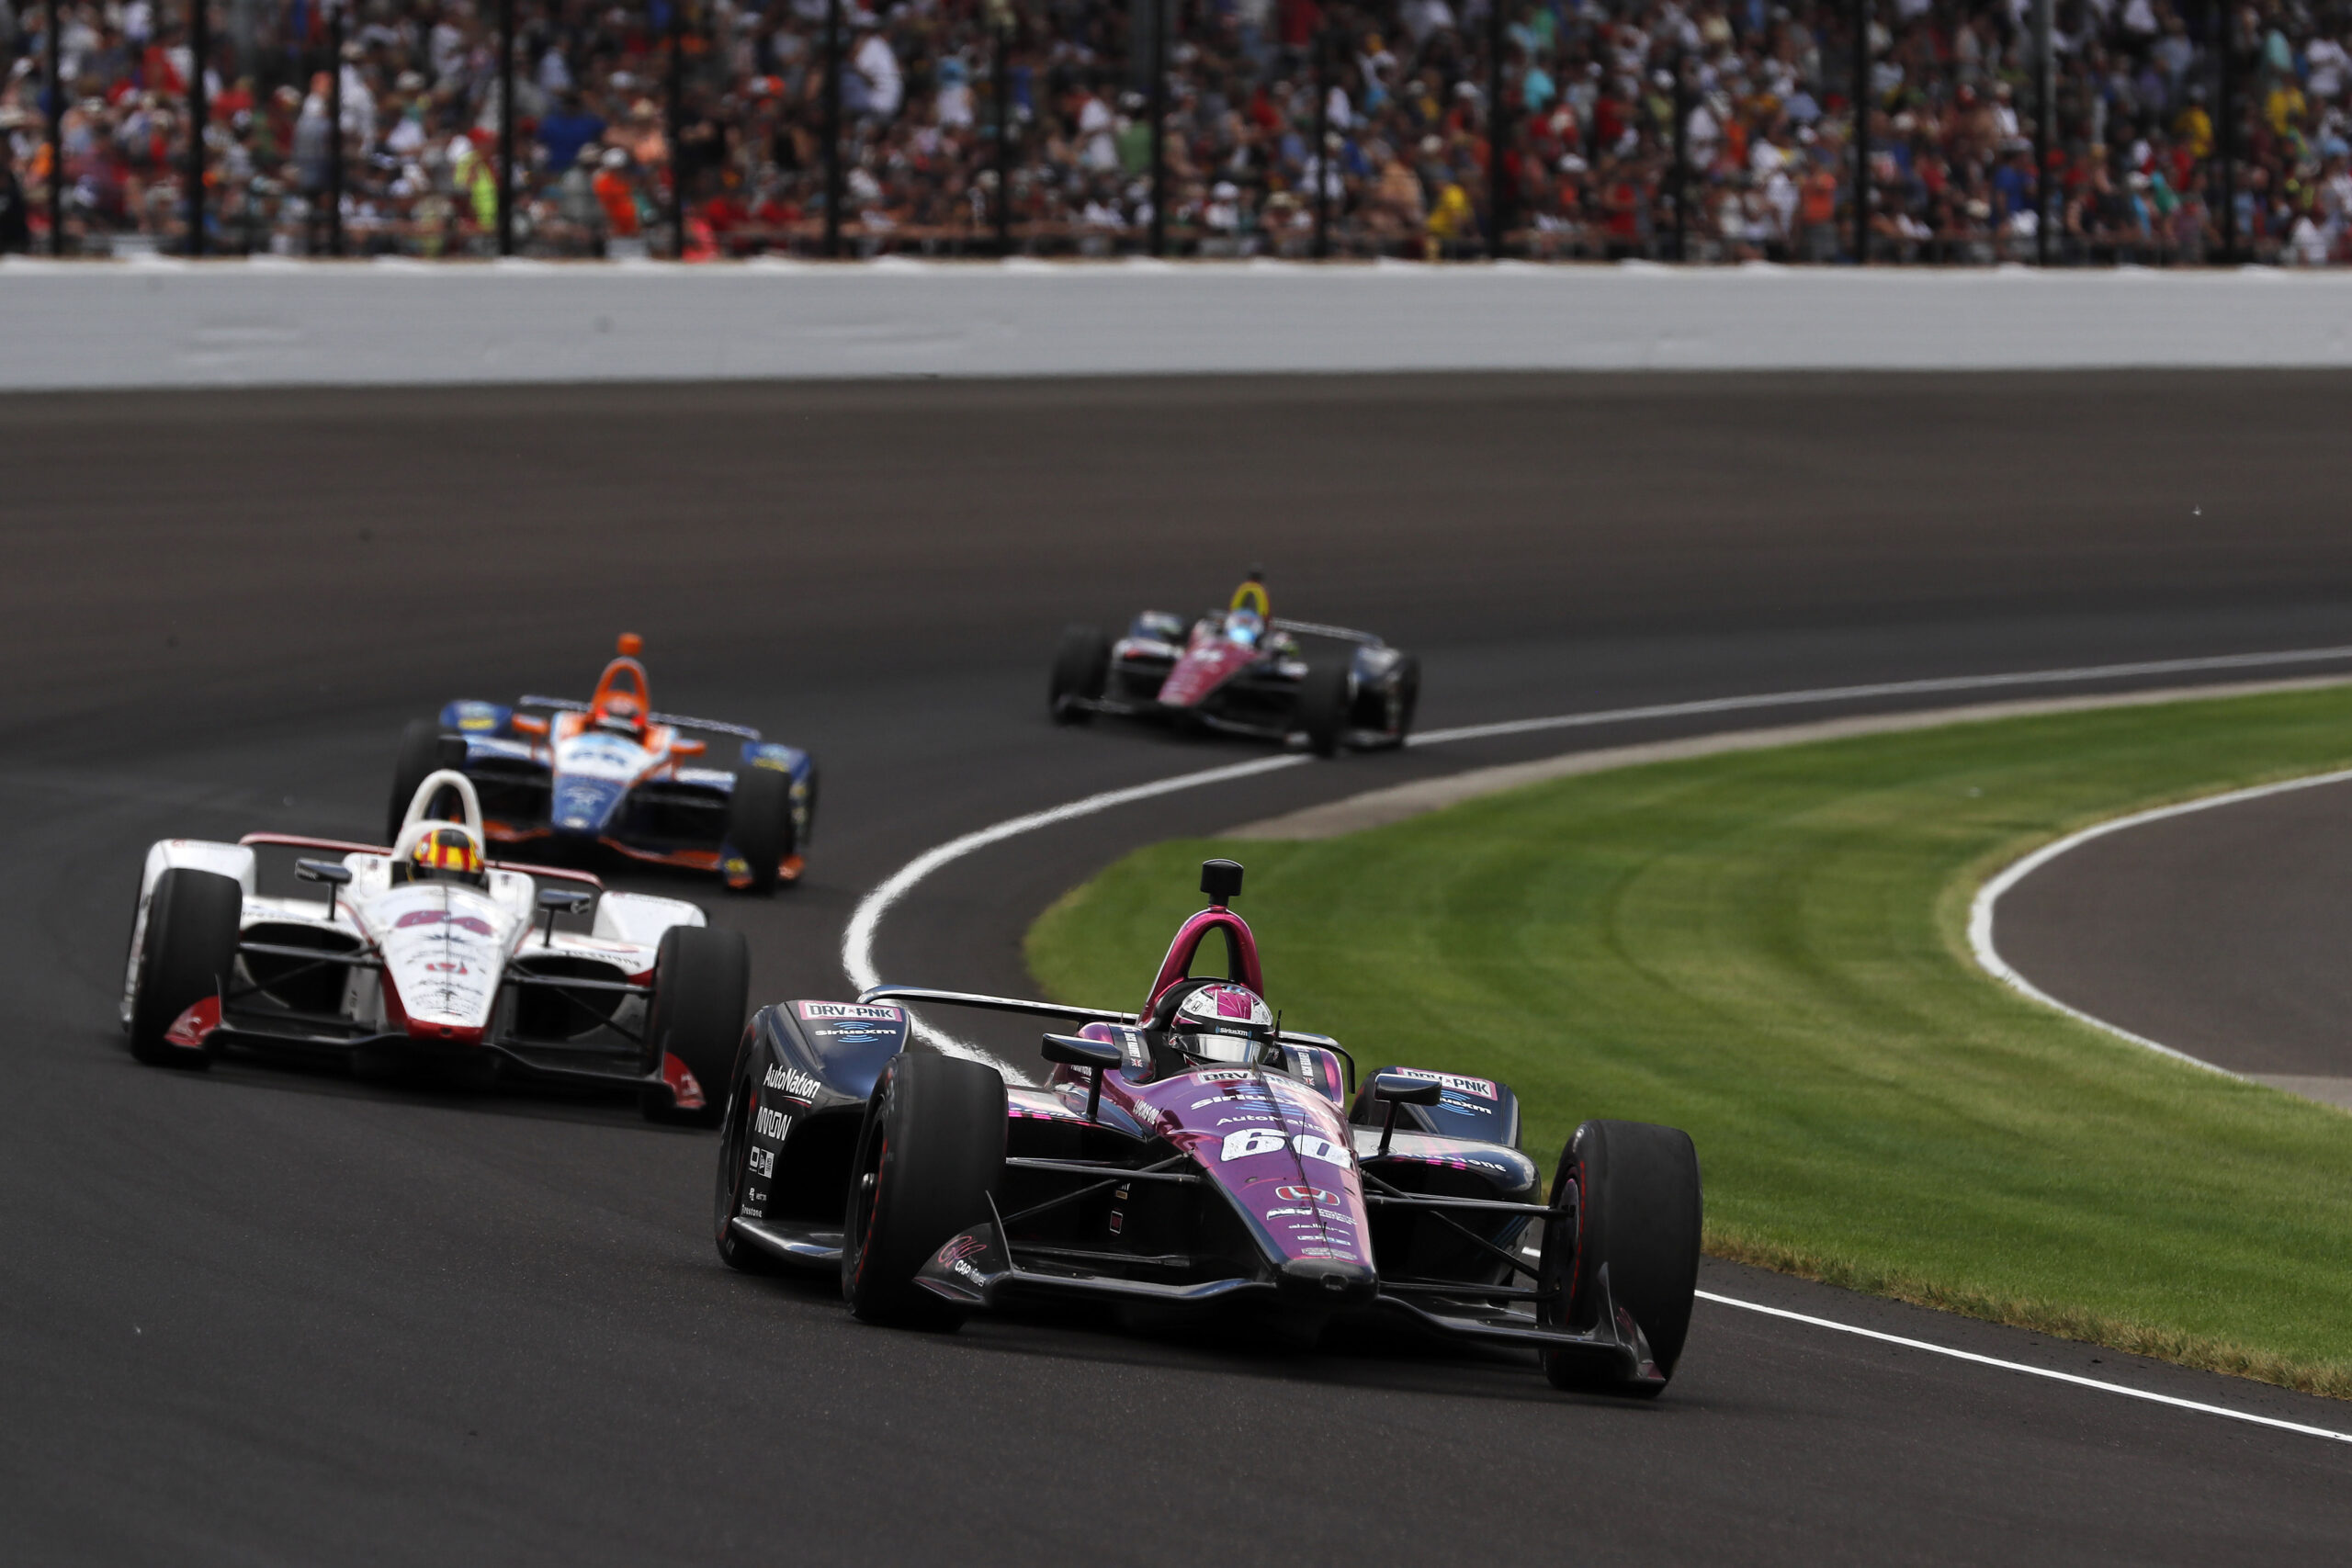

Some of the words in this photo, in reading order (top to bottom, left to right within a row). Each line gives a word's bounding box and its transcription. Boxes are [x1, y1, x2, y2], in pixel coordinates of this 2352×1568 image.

[808, 1005, 846, 1016] DRV
[855, 1008, 894, 1019] PNK
[763, 1063, 821, 1099] AutoNation
[1203, 1072, 1249, 1082] DRV
[1453, 1078, 1489, 1095] PNK
[1220, 1127, 1352, 1170] 60
[955, 1259, 971, 1276] CAP
